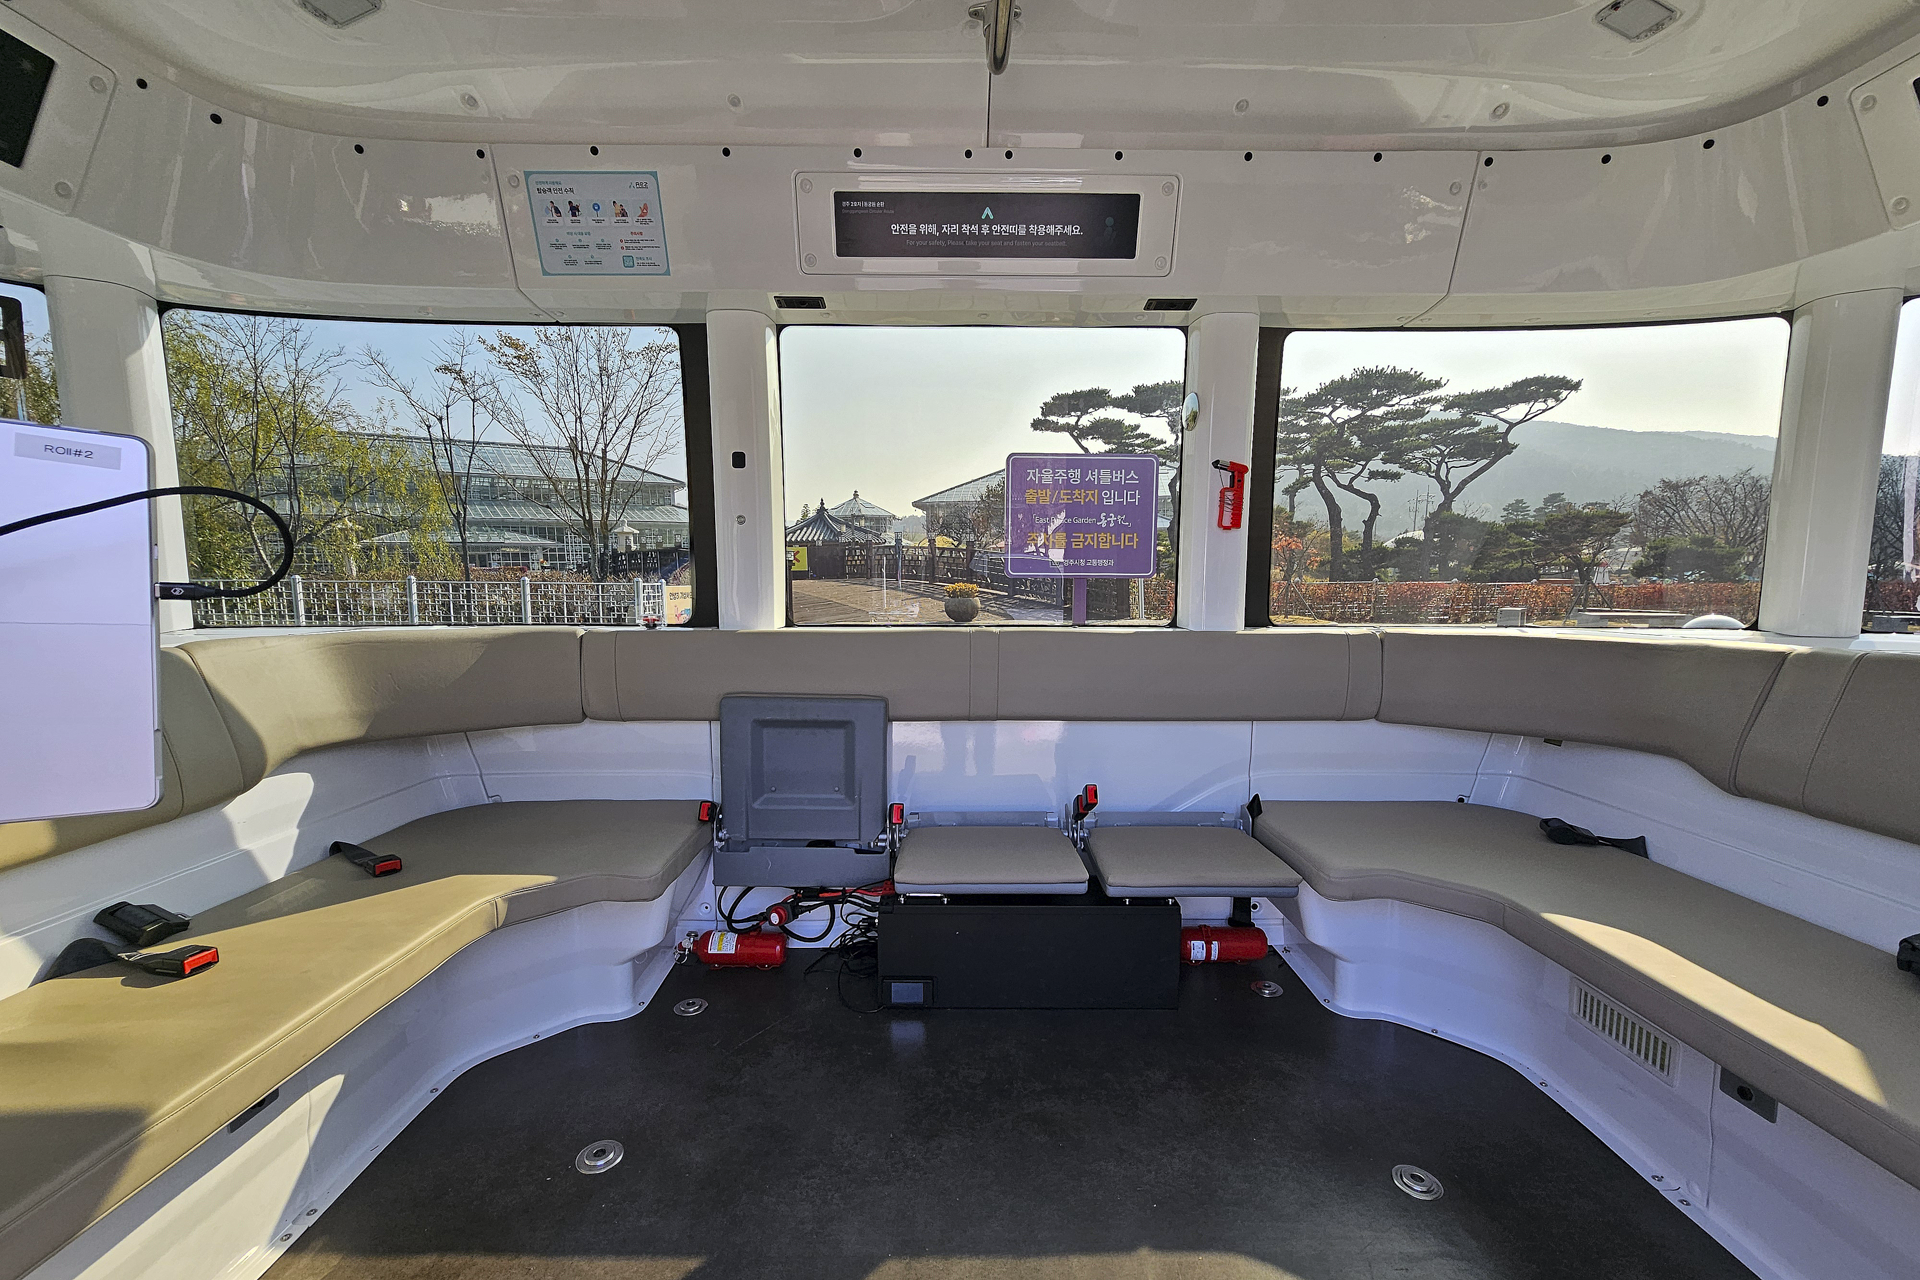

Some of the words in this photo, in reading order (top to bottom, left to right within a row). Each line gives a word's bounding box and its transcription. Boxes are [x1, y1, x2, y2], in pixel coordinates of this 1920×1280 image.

[891, 224, 917, 235] 안전을
[919, 224, 939, 236] 위해,
[942, 224, 959, 235] 자리
[961, 224, 979, 235] 착석
[981, 224, 990, 235] 후
[992, 224, 1027, 236] 안전띠를
[1028, 224, 1083, 236] 착용해주세요.
[1026, 468, 1081, 484] 자율주행
[1085, 469, 1139, 484] 셔틀버스
[1025, 488, 1099, 504] 출발/도착지
[1102, 490, 1140, 505] 입니다
[1070, 532, 1138, 549] 금지합니다
